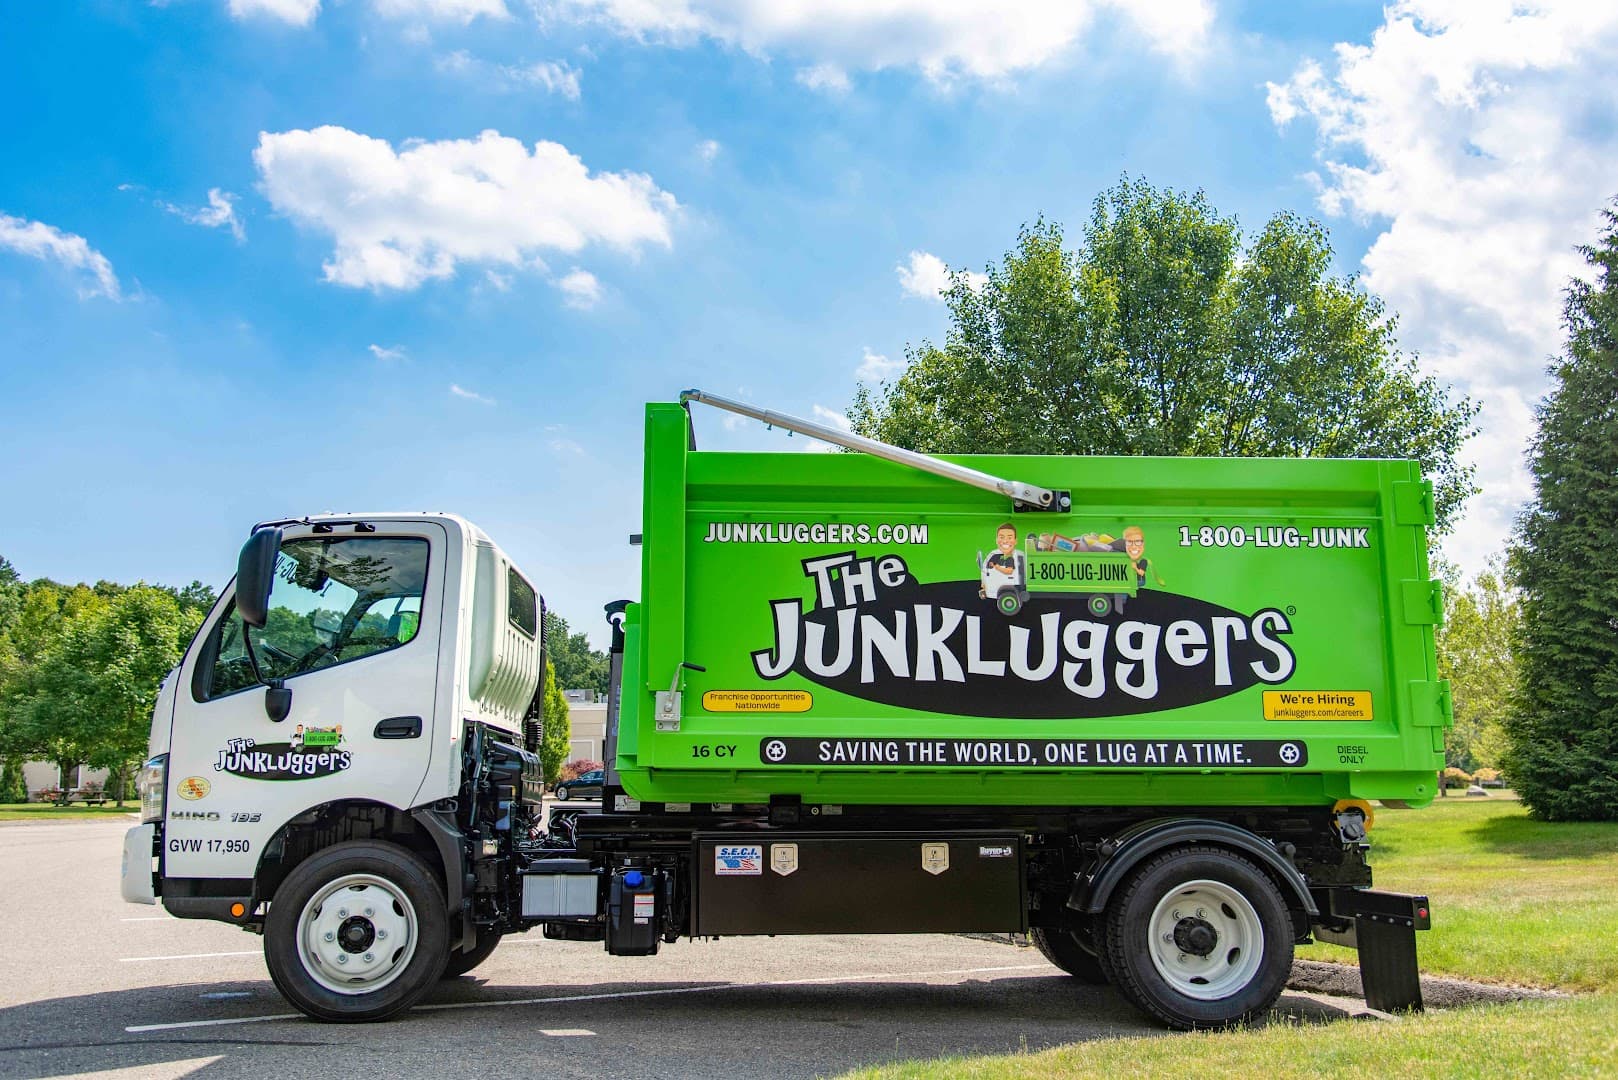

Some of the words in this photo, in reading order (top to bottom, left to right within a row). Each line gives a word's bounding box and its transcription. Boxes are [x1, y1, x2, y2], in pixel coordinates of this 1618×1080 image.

[703, 522, 929, 544] JUNKLUGGERS.COM
[1178, 525, 1371, 548] 1-800-LUG-JUNK
[1029, 562, 1129, 581] 1-800-LUG-JUNK
[710, 693, 749, 701] Franchise
[750, 693, 805, 702] Opportunities
[1280, 694, 1314, 704] We're
[1317, 694, 1355, 706] Hiring
[1273, 708, 1365, 719] junkluggers.com/careers
[692, 745, 710, 758] 16
[715, 745, 737, 757] CY
[818, 741, 899, 762] SAVING
[905, 742, 946, 762] THE
[953, 742, 1038, 766] WORLD,
[1044, 743, 1088, 763] ONE
[1096, 743, 1137, 763] LUG
[1144, 743, 1168, 763] AT
[1175, 743, 1189, 763] A
[1192, 743, 1252, 763] TIME.
[1337, 745, 1369, 754] DIESEL
[1340, 755, 1365, 764] ONLY
[171, 811, 220, 821] HINO
[231, 812, 261, 823] 195
[169, 839, 202, 852] GVW
[207, 840, 250, 855] 17,950
[720, 847, 758, 856] S.E.C.I.
